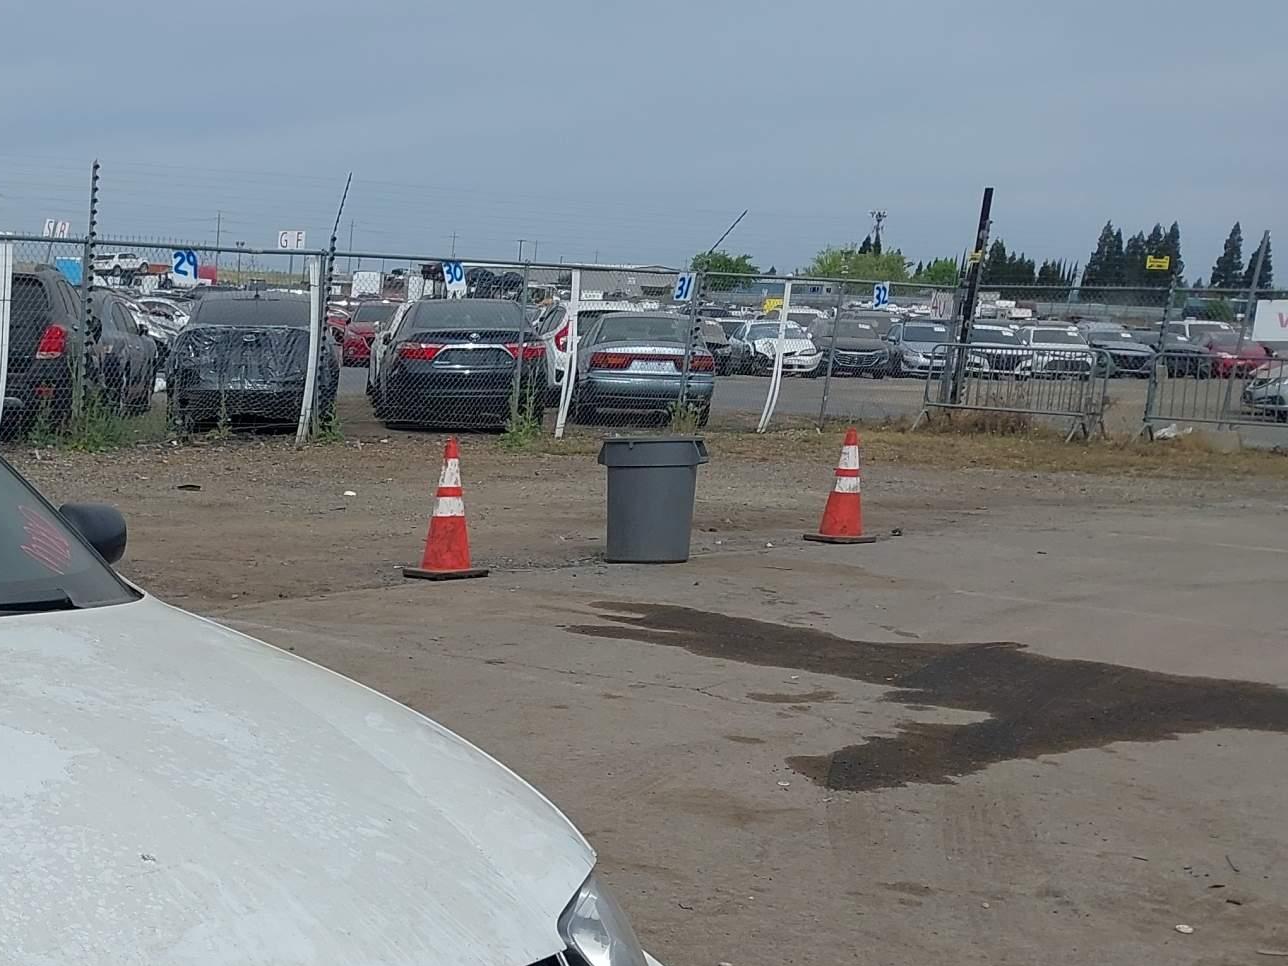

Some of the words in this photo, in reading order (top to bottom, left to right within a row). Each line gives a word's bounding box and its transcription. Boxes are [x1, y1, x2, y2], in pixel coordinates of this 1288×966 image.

[296, 231, 303, 249] F
[173, 250, 198, 279] 29
[443, 261, 464, 284] 30
[675, 276, 692, 299] 31
[874, 286, 888, 308] 32
